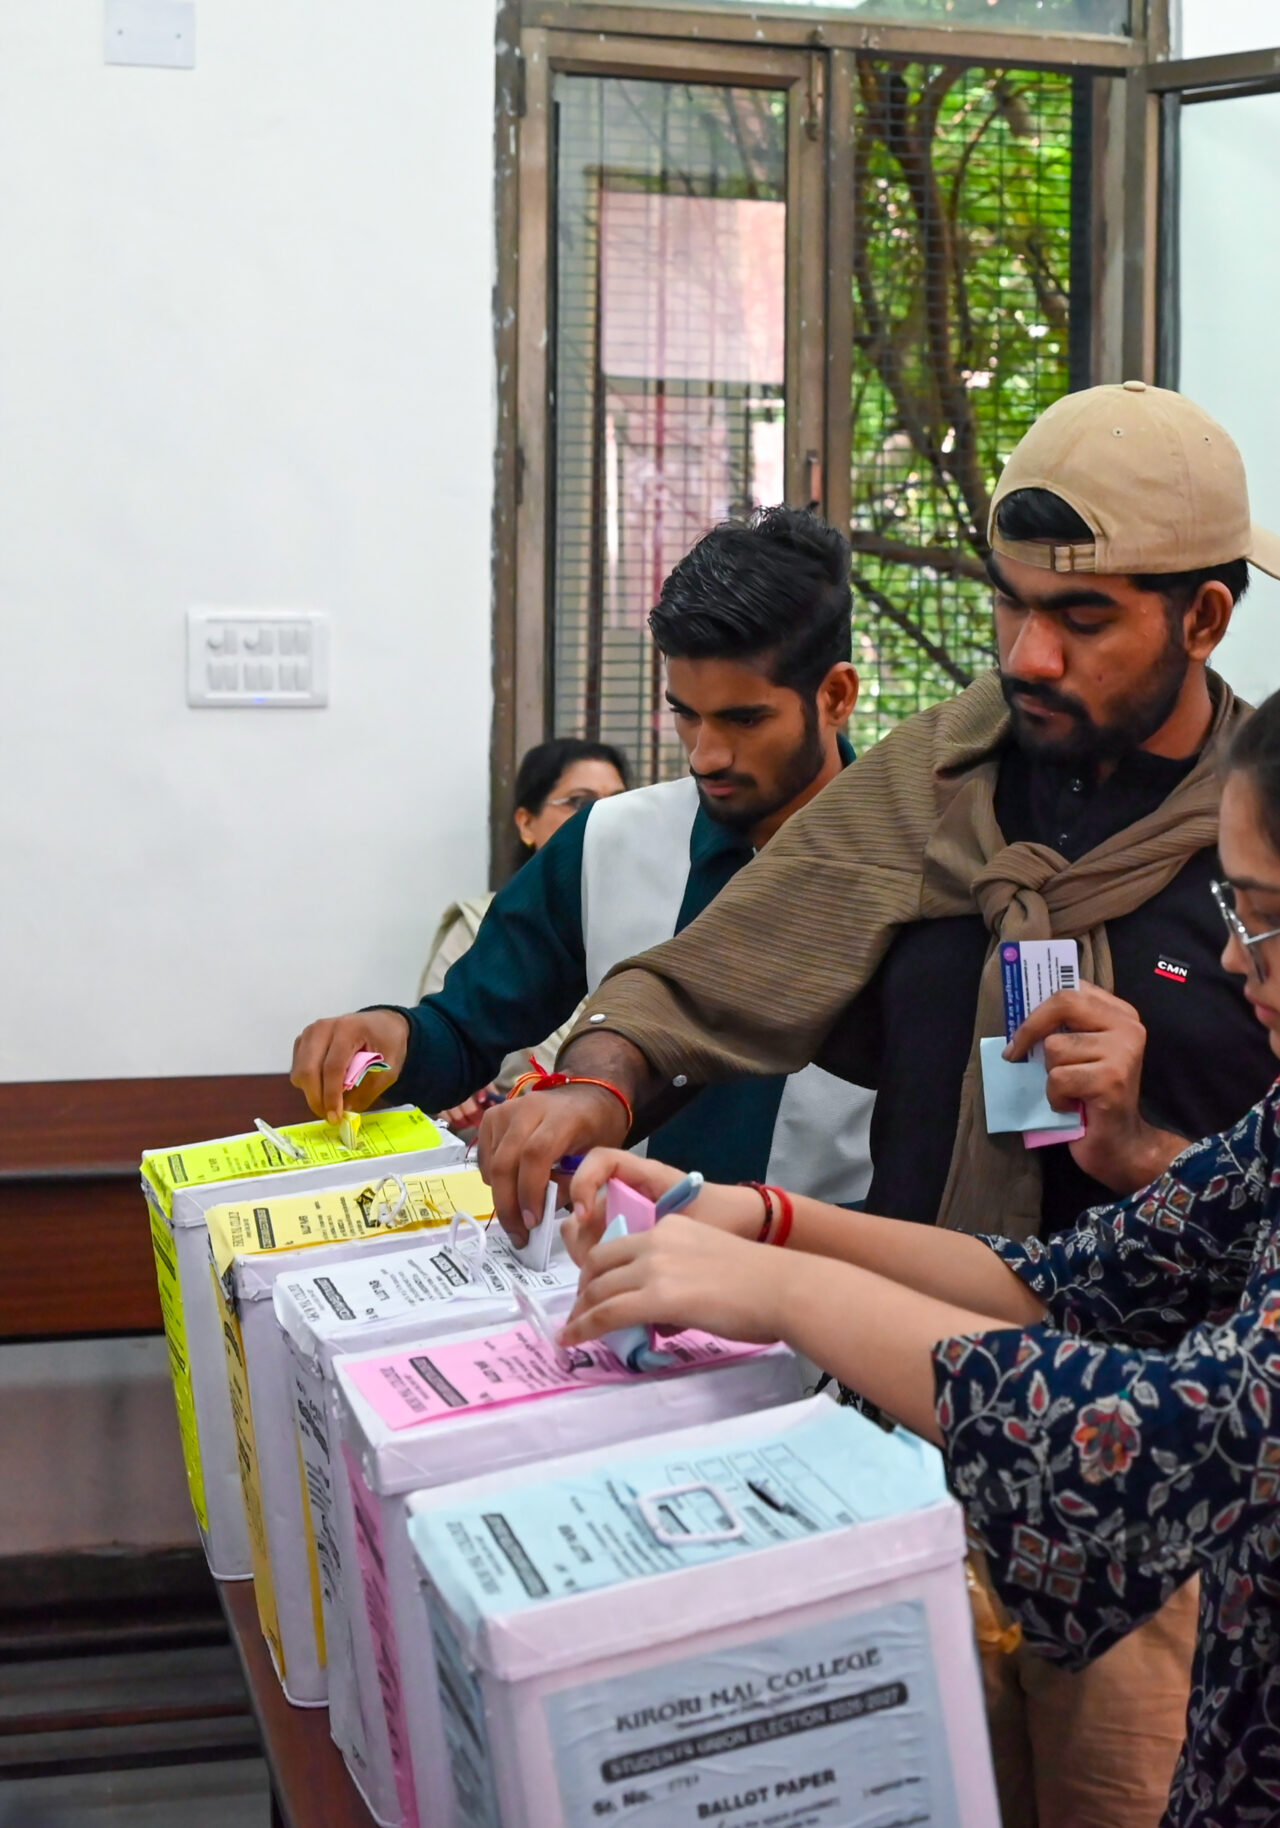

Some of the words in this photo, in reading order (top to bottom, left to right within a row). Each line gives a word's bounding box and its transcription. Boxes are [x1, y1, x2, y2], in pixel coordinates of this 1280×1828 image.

[1157, 961, 1188, 977] CMN
[615, 1696, 702, 1733] KIRORI
[710, 1681, 760, 1708] MAL
[767, 1648, 882, 1693] COLLEGE
[750, 1706, 826, 1741] ELECTION
[697, 1786, 769, 1820] BALLOT
[774, 1768, 837, 1798] PAPER
